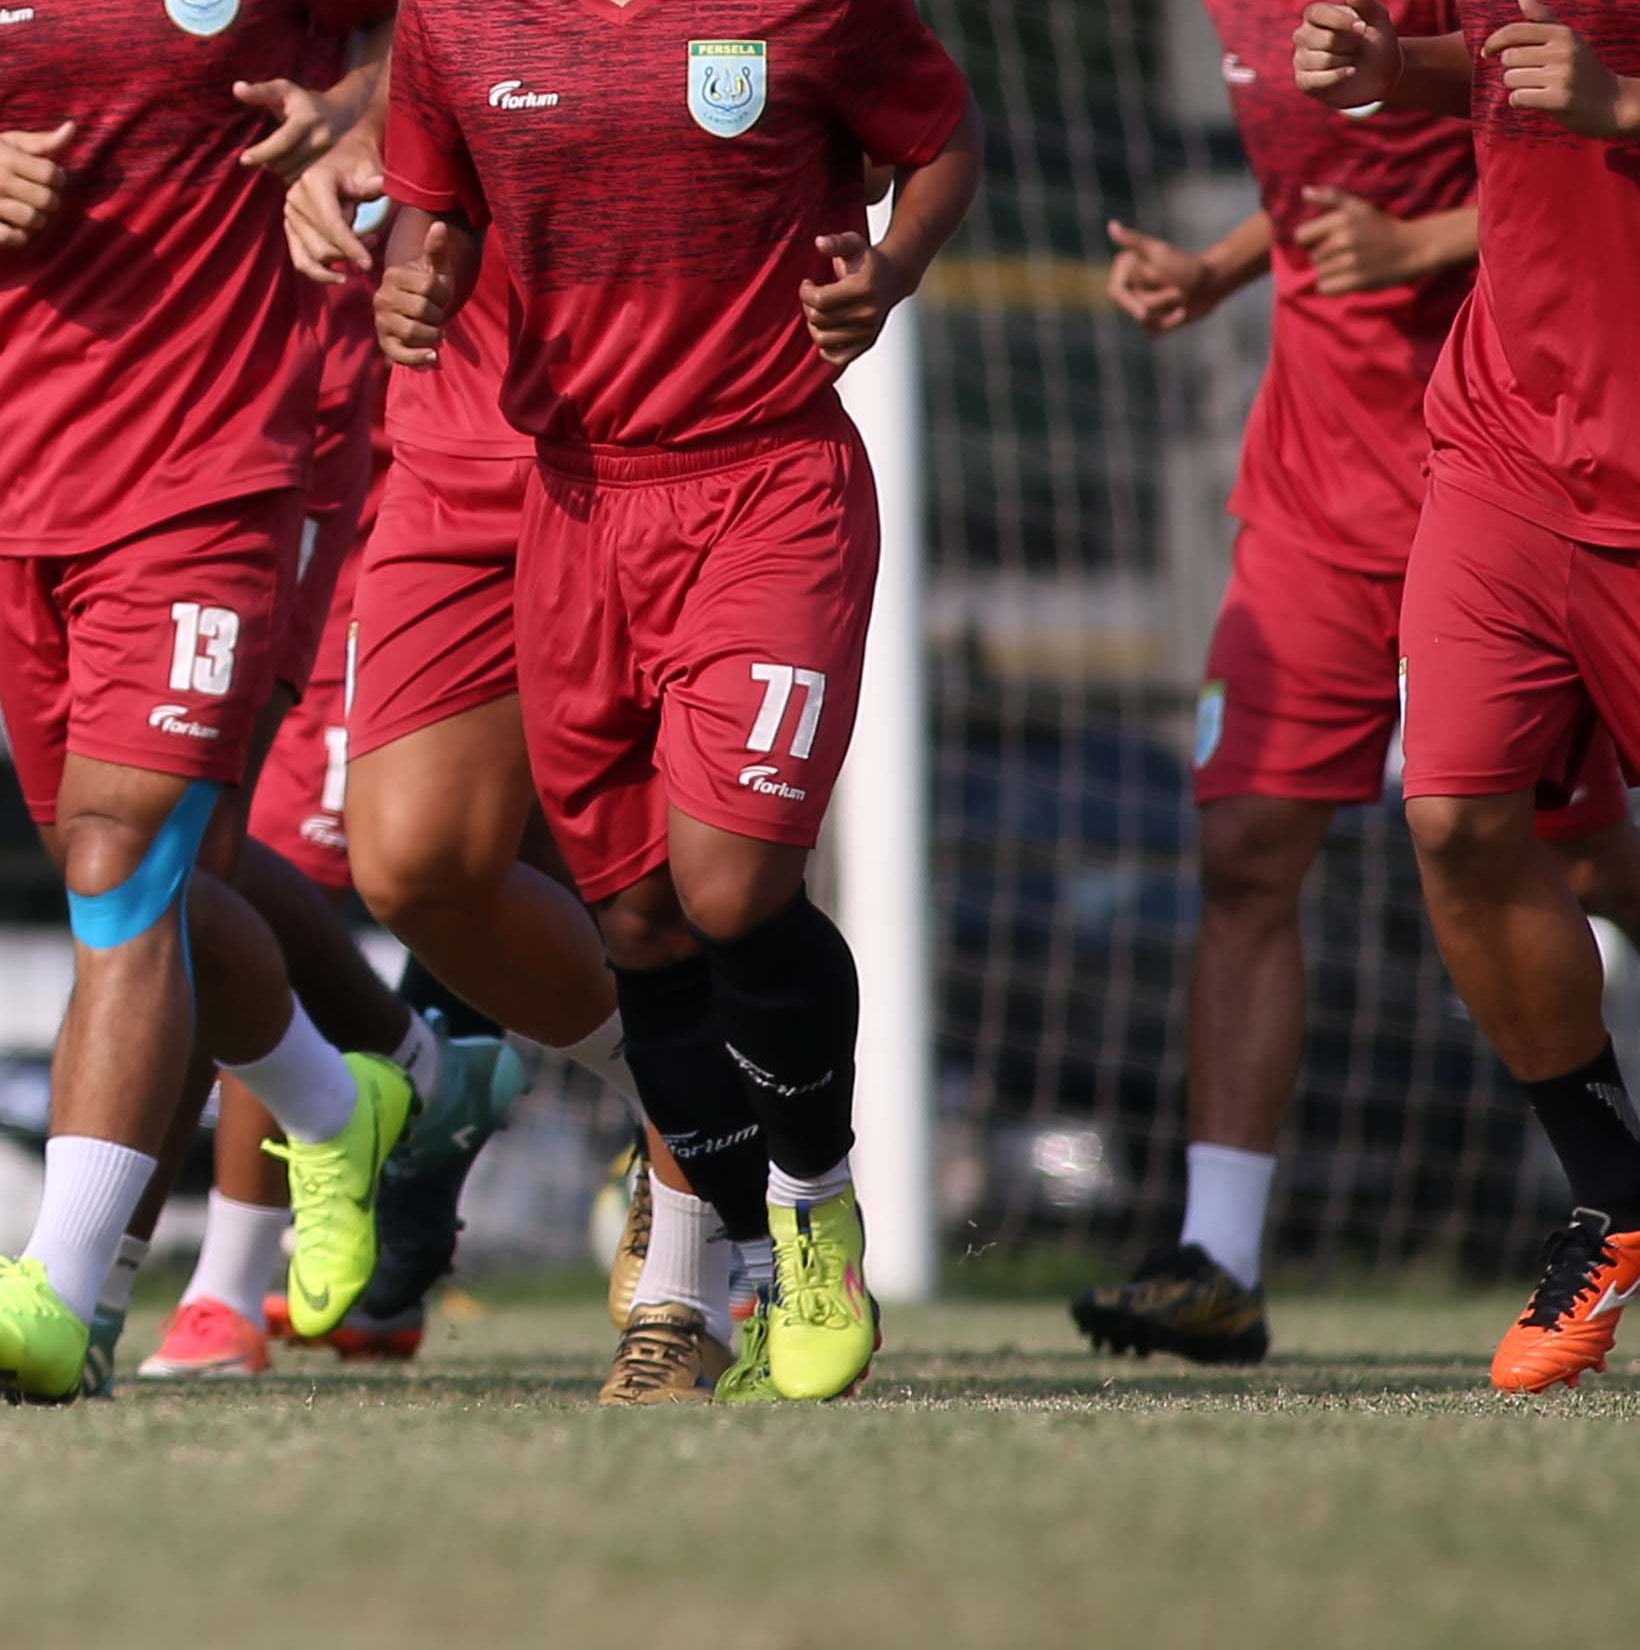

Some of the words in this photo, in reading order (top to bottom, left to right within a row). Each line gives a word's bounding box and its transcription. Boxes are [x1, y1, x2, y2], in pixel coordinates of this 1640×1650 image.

[698, 44, 755, 55] PERSELA
[169, 601, 240, 696] 13
[746, 663, 826, 760] 77
